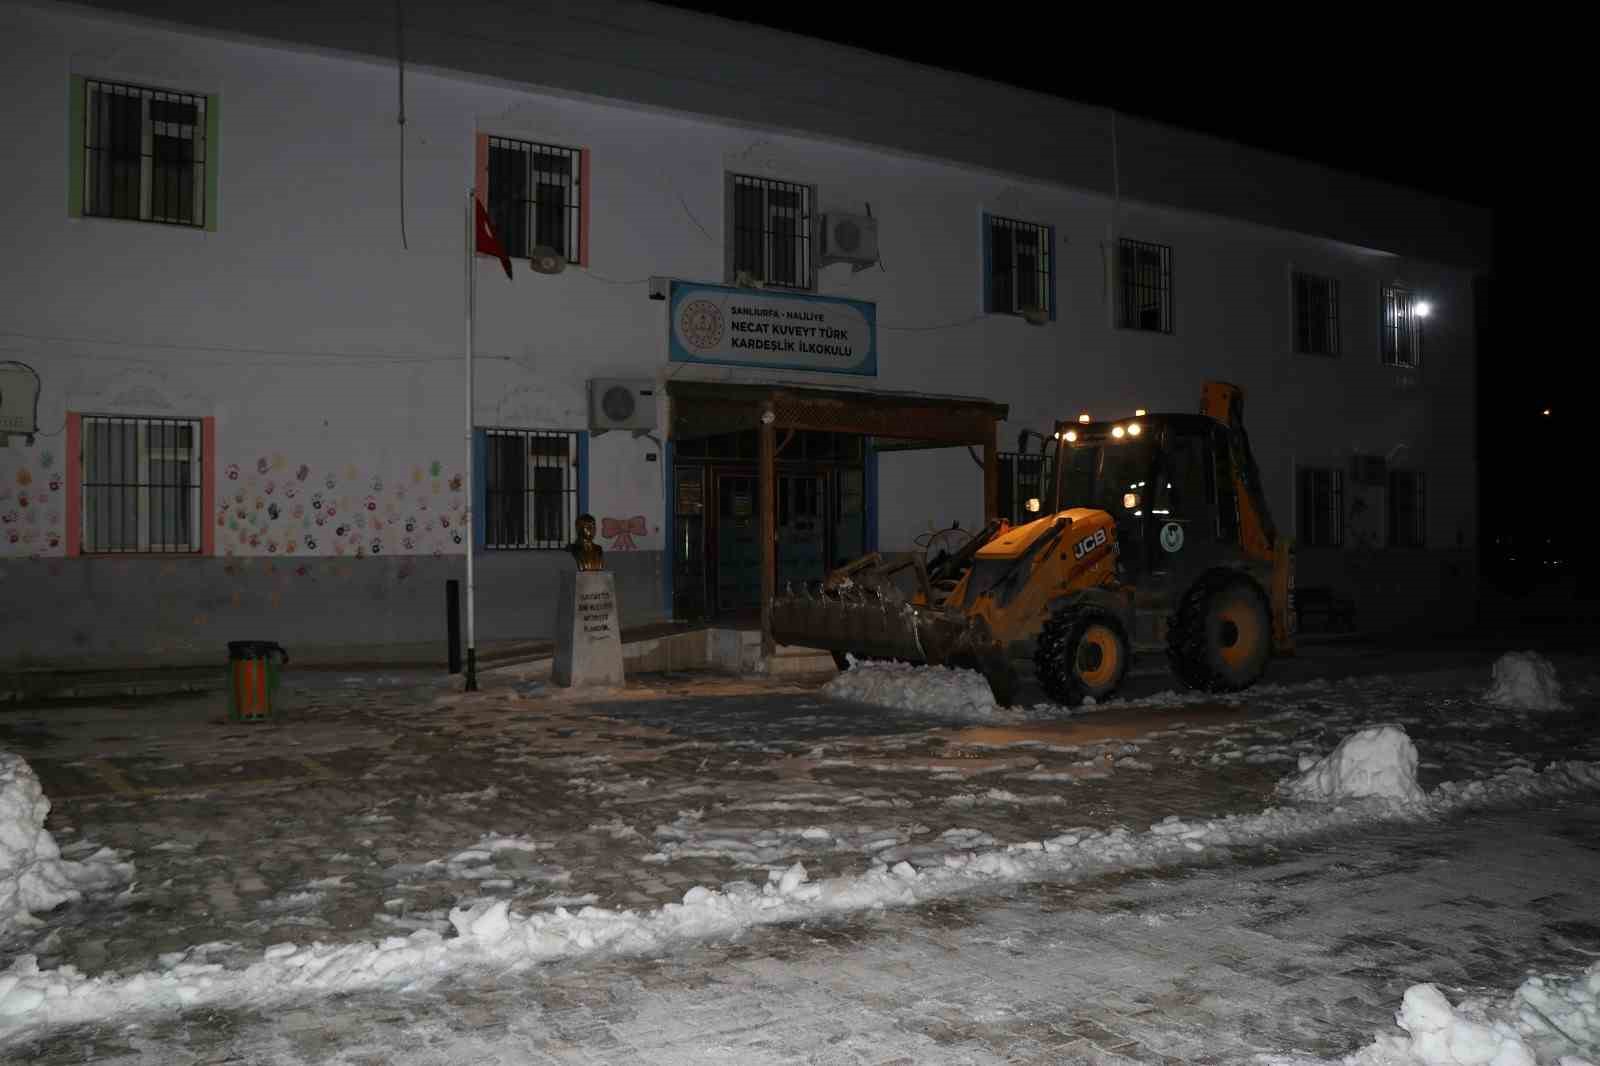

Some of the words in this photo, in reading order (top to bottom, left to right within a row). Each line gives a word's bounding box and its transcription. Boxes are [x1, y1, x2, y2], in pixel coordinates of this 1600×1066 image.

[731, 321, 769, 333] NECAT
[772, 324, 816, 337] KUVEYT
[819, 327, 849, 341] TÜRK
[1075, 529, 1106, 559] JCB
